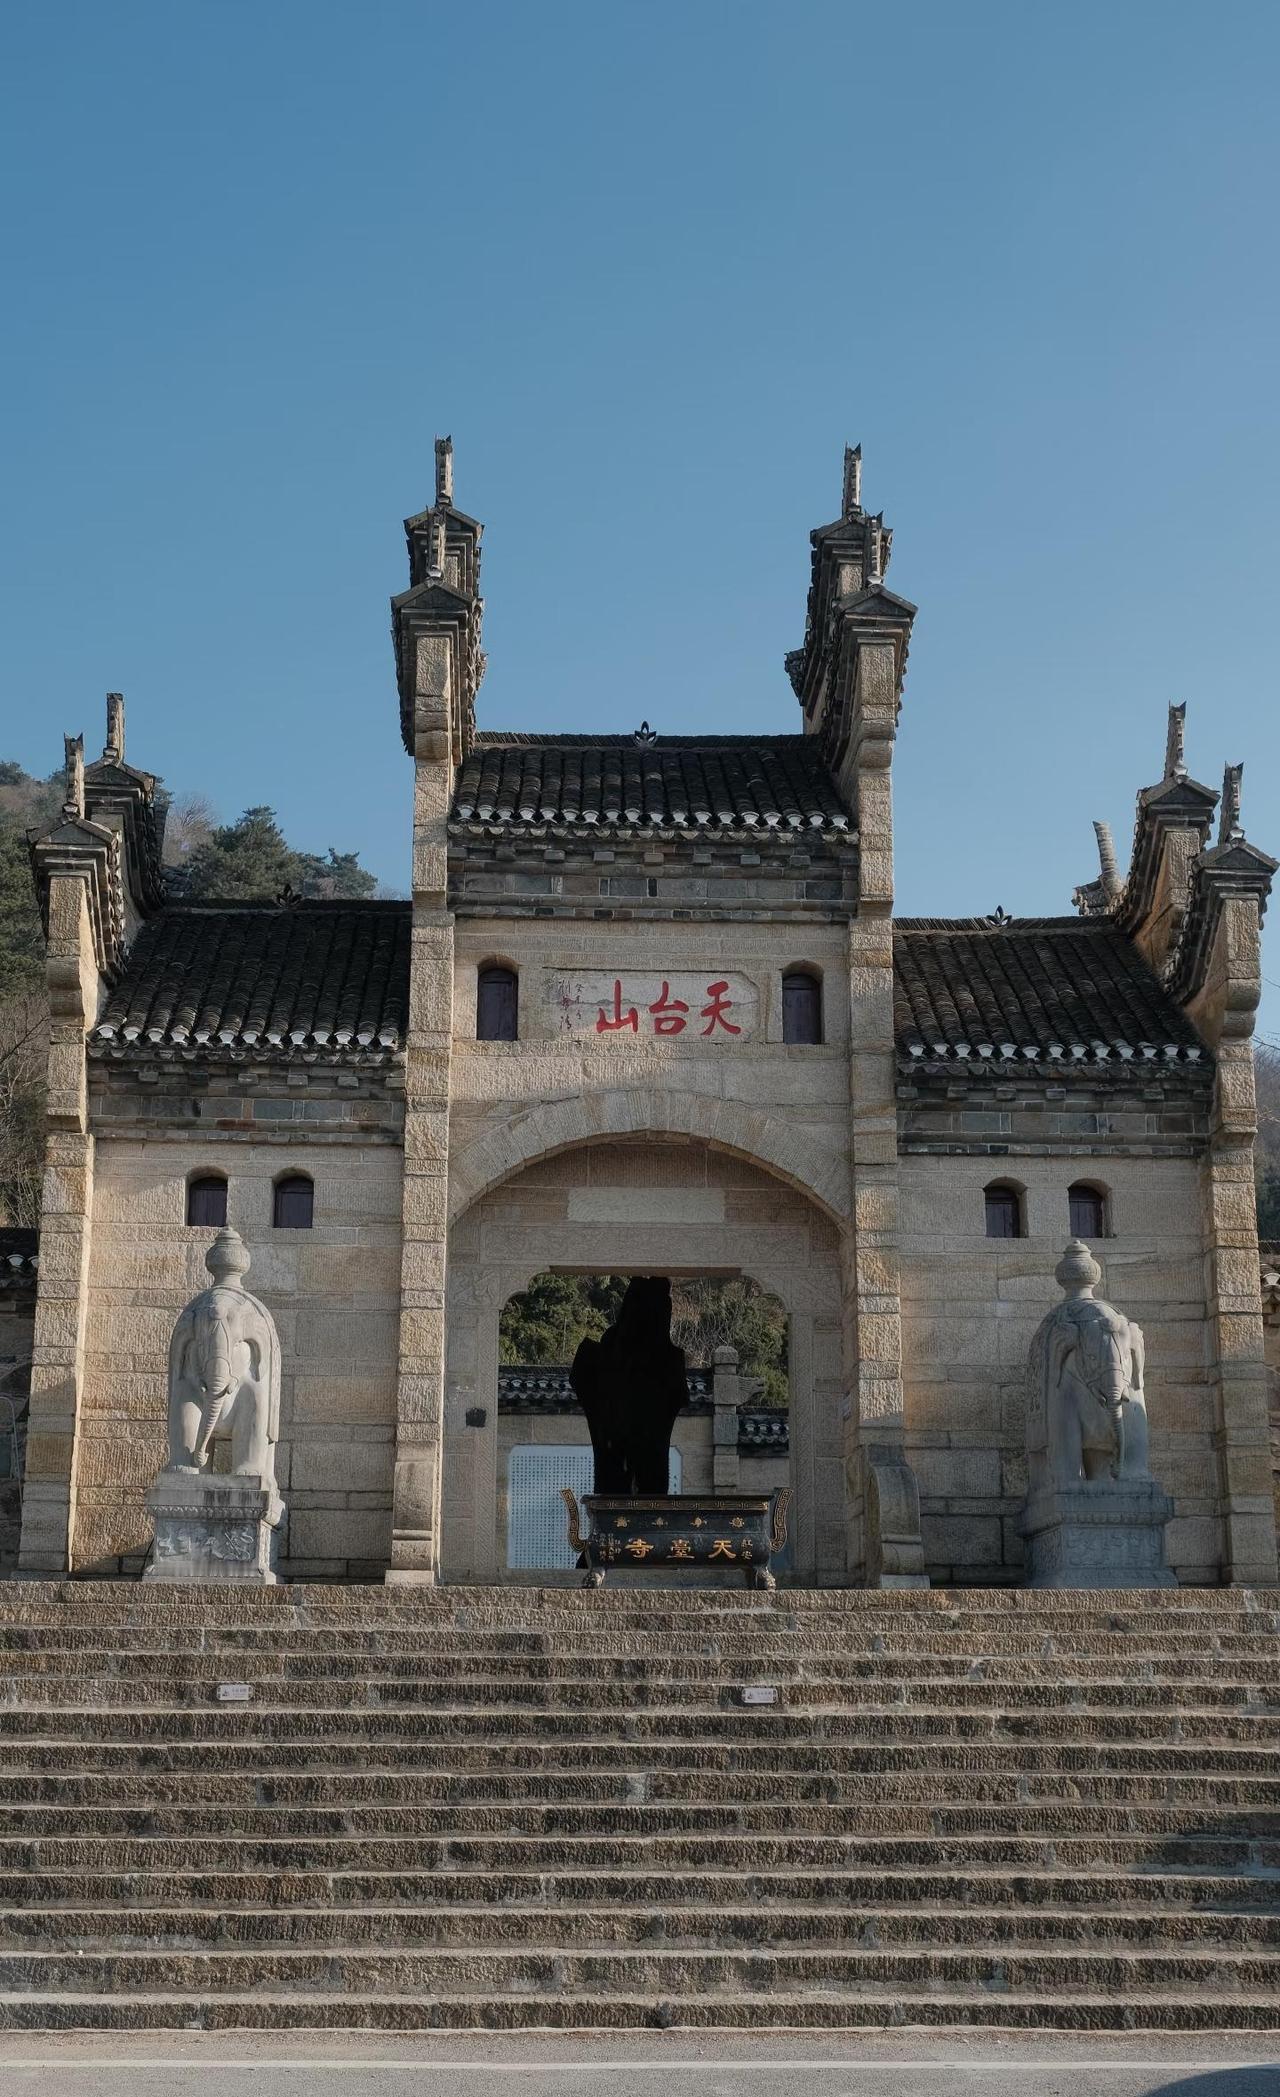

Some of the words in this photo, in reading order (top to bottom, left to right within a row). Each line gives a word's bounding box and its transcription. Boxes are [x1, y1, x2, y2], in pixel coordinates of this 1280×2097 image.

[596, 979, 742, 1036] 天台山
[624, 1537, 737, 1559] 天臺寺
